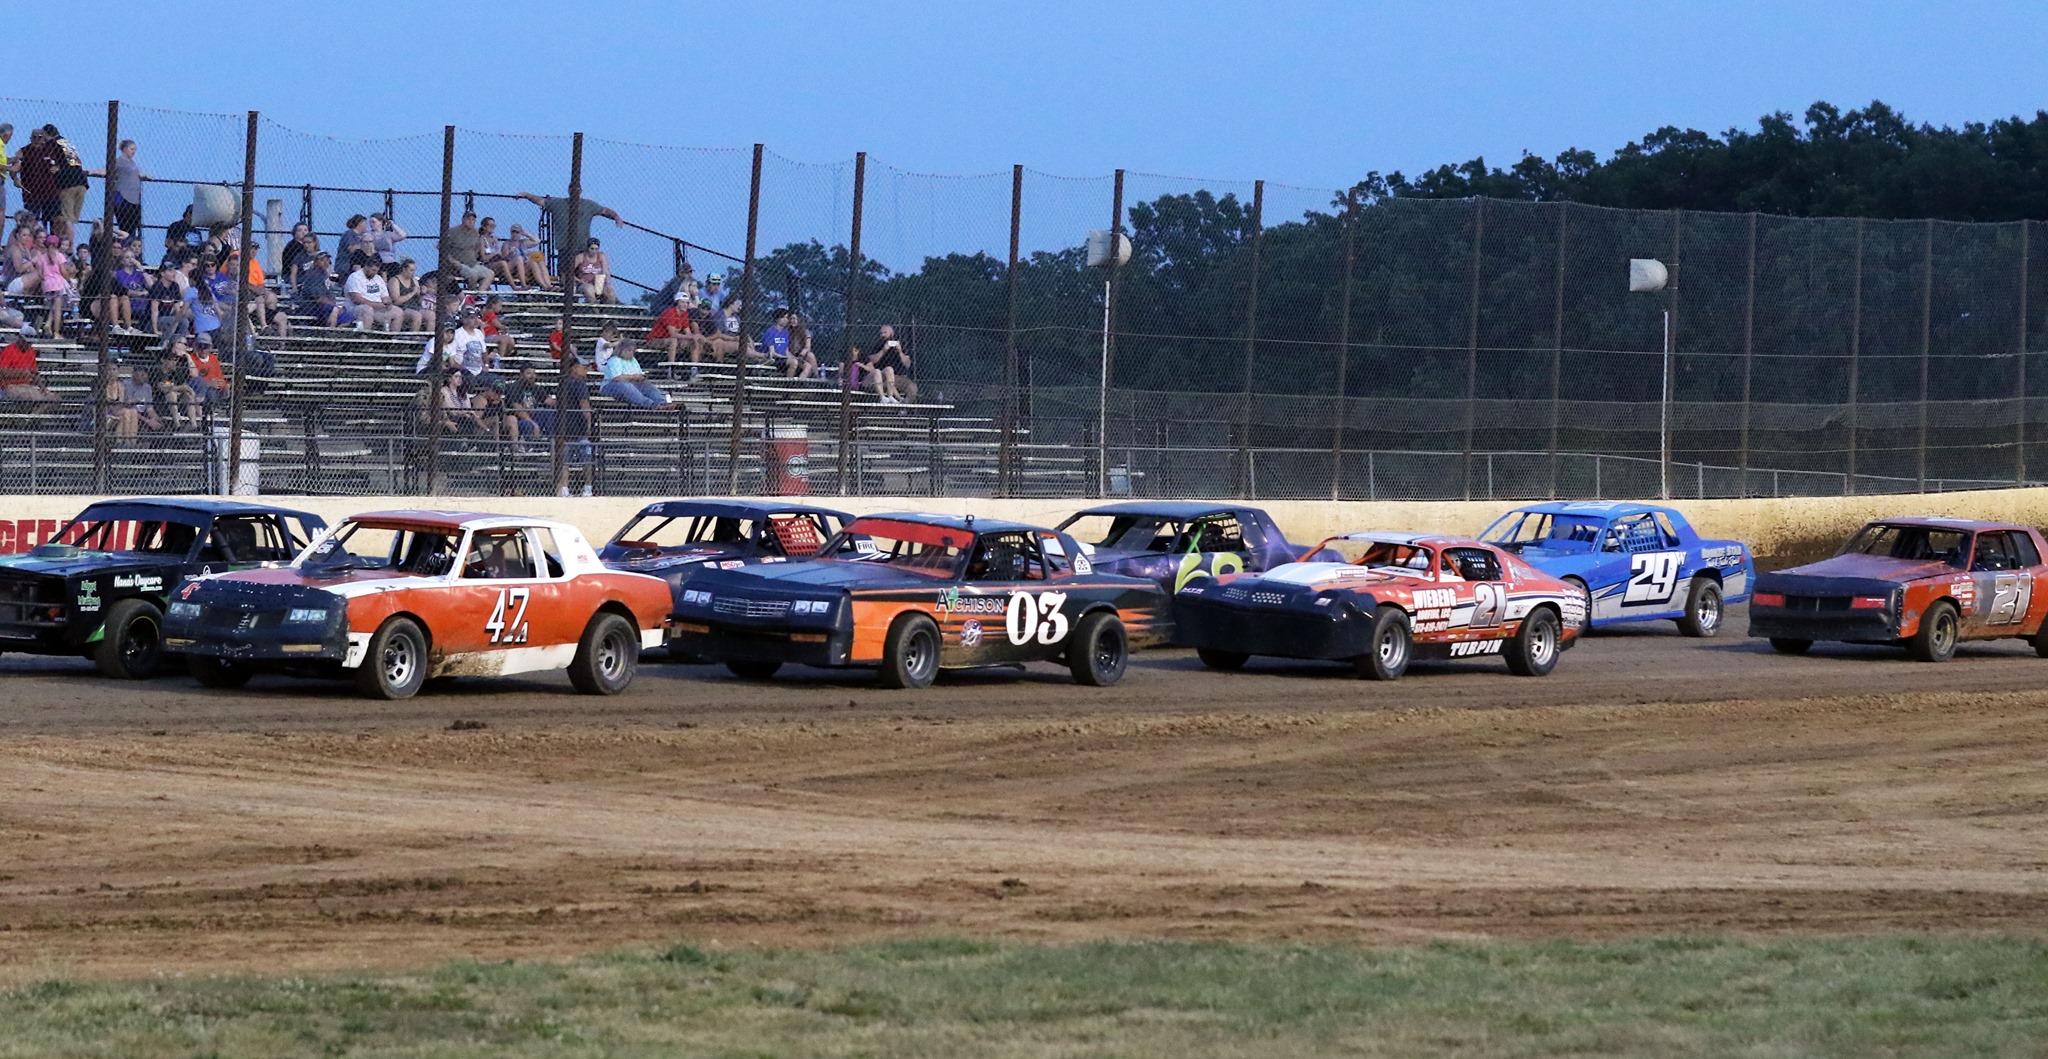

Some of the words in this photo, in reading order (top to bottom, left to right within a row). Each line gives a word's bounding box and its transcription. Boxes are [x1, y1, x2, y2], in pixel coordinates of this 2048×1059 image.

[114, 574, 134, 588] Nana's
[135, 573, 163, 588] Daycare
[935, 587, 1005, 613] ATCHISON
[1412, 587, 1457, 609] WIEBERG
[1986, 573, 2032, 625] 21
[1006, 590, 1069, 646] 03
[1449, 639, 1504, 657] TURPIN
